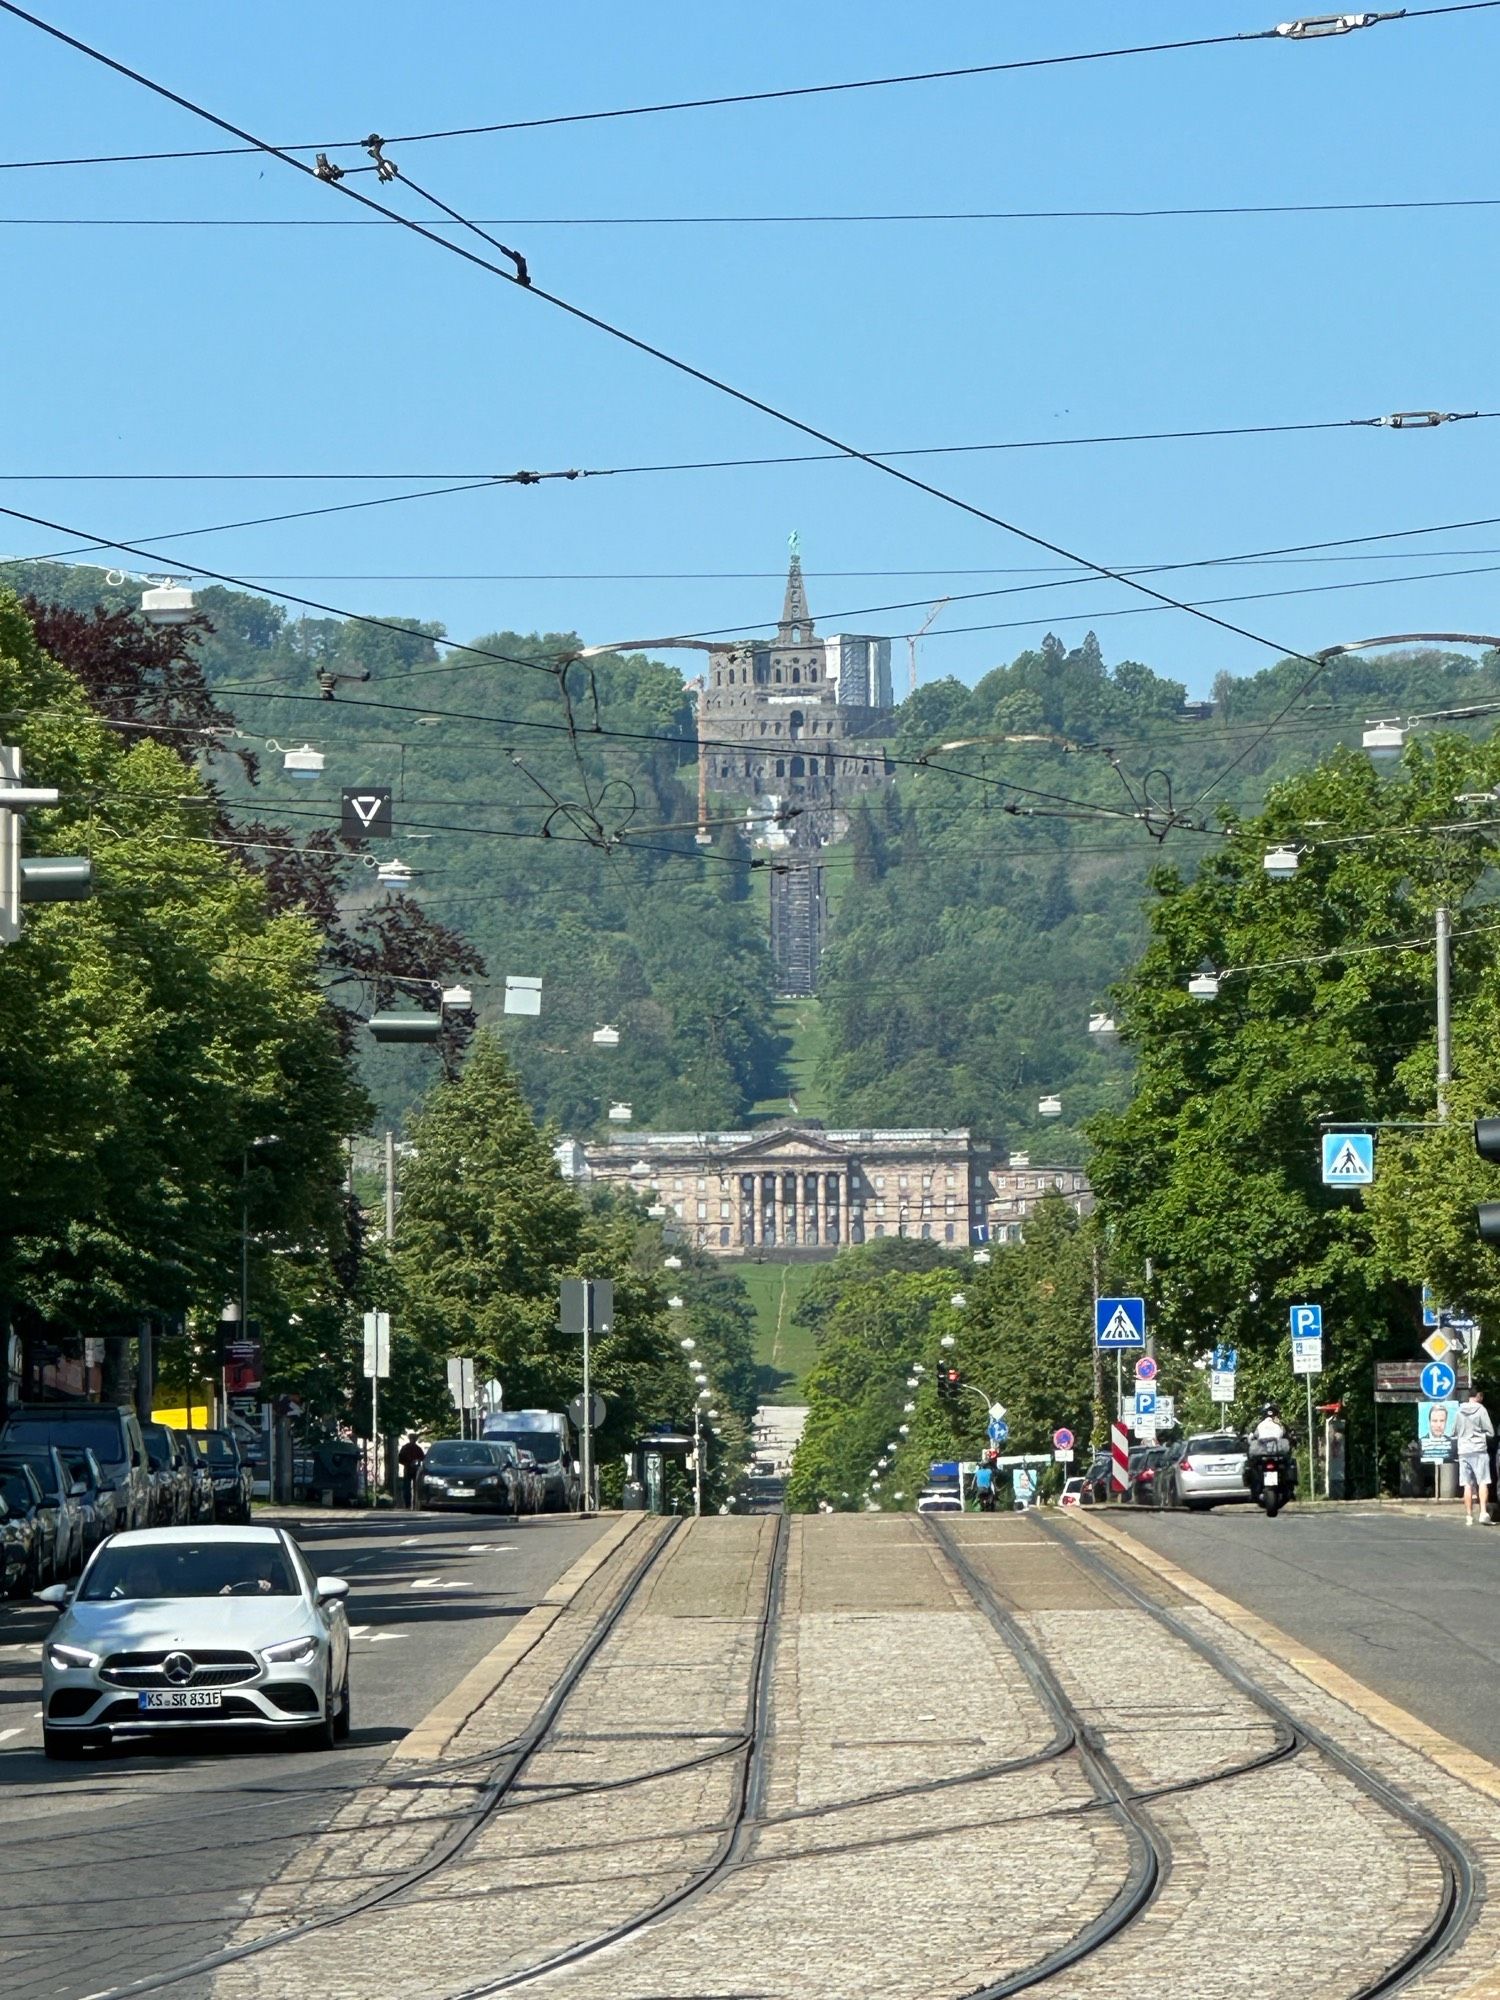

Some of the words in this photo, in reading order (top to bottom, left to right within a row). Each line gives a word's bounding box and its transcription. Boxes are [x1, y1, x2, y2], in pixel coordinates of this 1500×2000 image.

[1297, 1309, 1314, 1335] P
[1139, 1394, 1152, 1411] P
[147, 1693, 163, 1706] KS
[172, 1693, 187, 1706] SR
